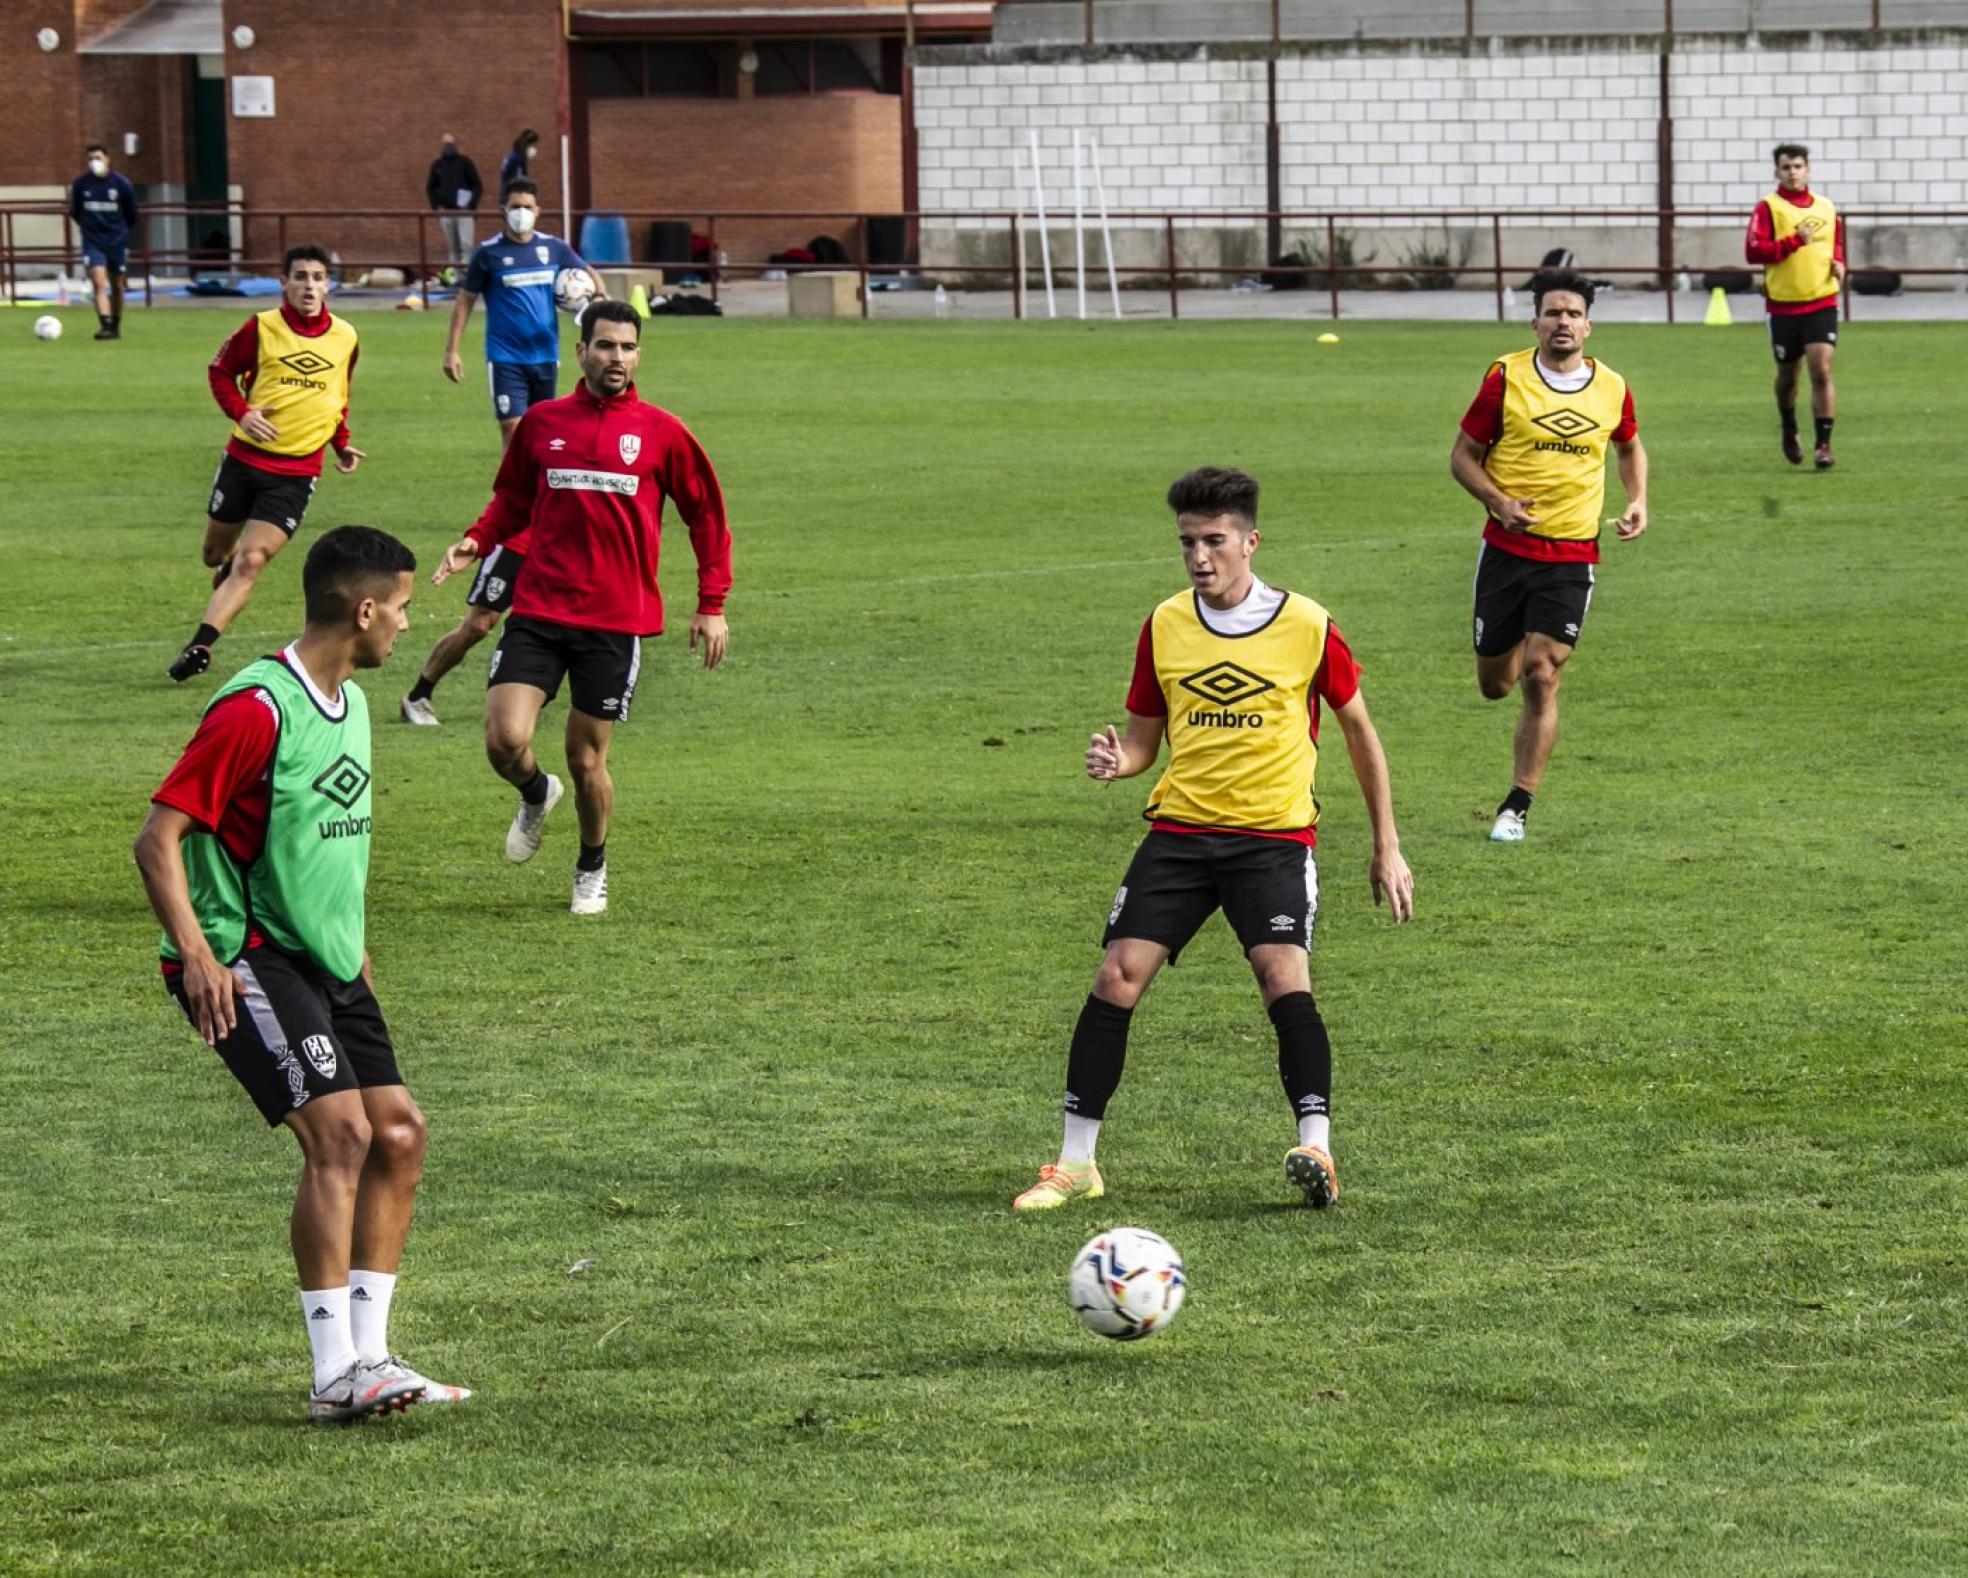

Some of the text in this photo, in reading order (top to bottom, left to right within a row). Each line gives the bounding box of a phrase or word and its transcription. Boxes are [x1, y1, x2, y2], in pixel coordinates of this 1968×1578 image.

[281, 376, 326, 390] umbro
[1534, 441, 1590, 455] umbro
[1187, 709, 1263, 729] umbro
